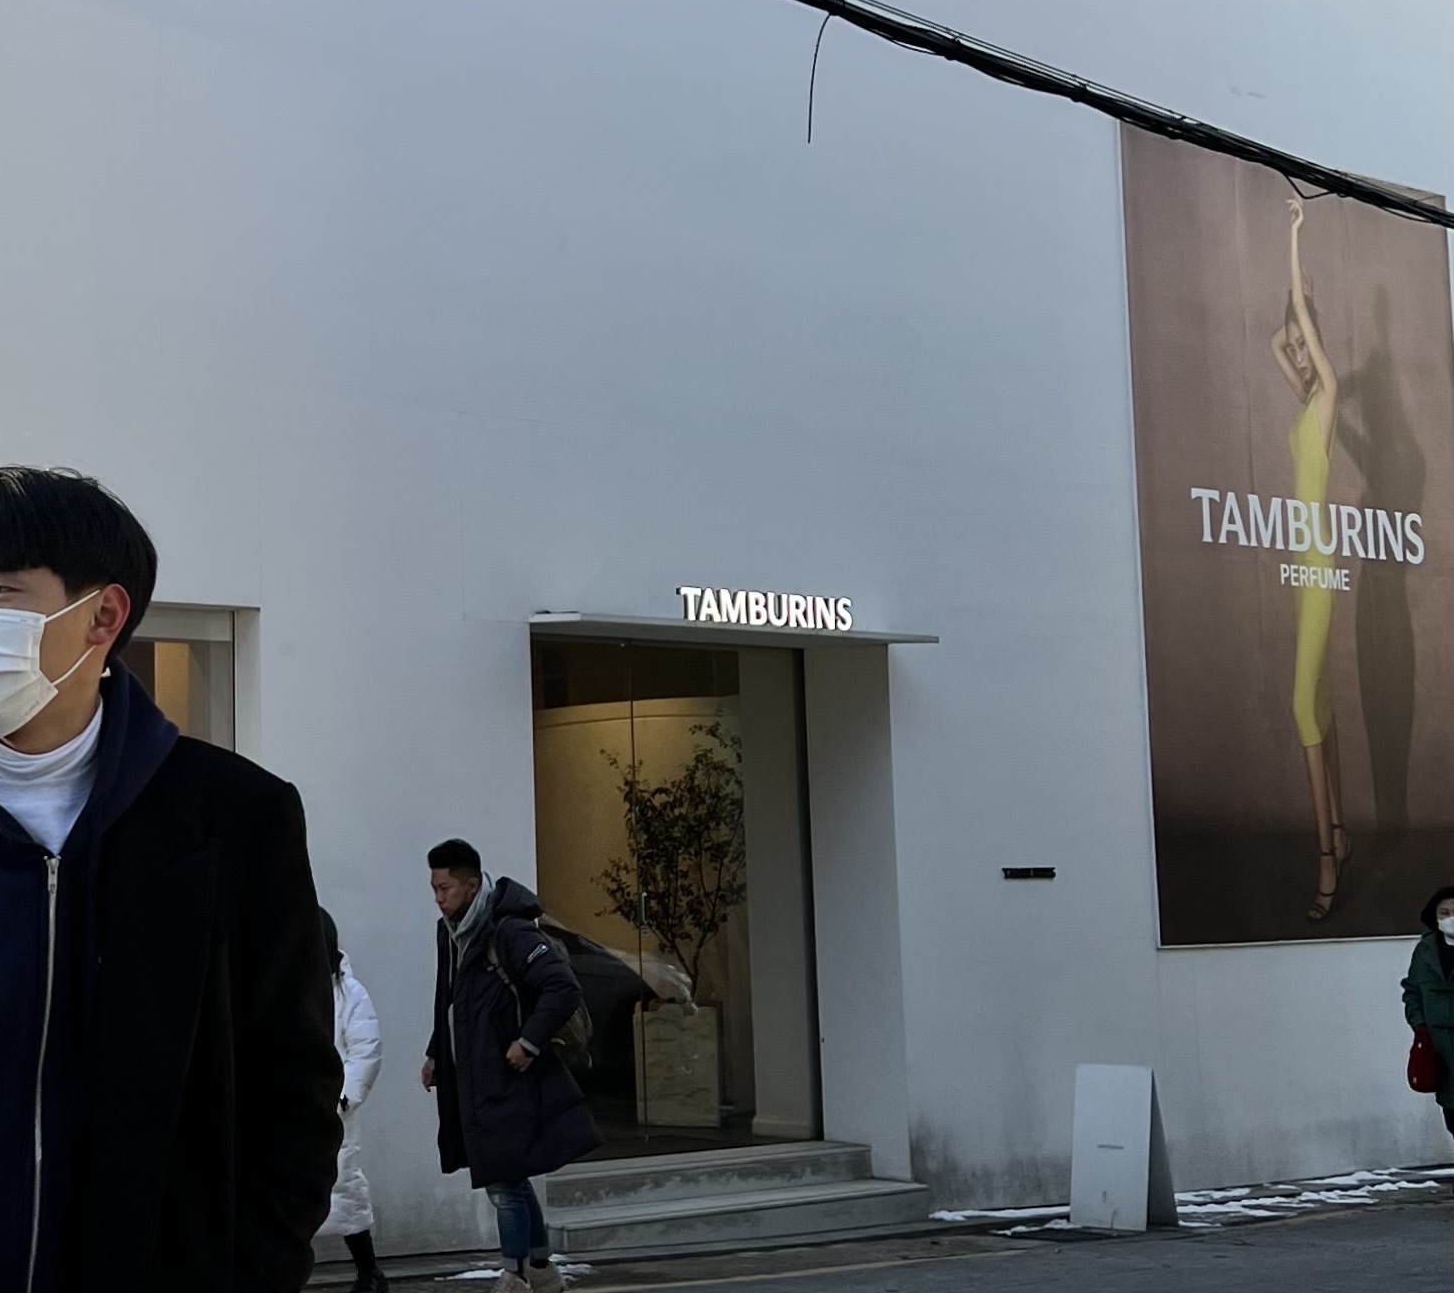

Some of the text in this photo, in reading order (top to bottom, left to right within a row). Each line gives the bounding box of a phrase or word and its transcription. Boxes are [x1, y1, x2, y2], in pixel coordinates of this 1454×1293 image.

[1191, 487, 1426, 565] TAMBURINS
[1279, 563, 1351, 591] PERFUME
[677, 586, 853, 631] TAMBURINS
